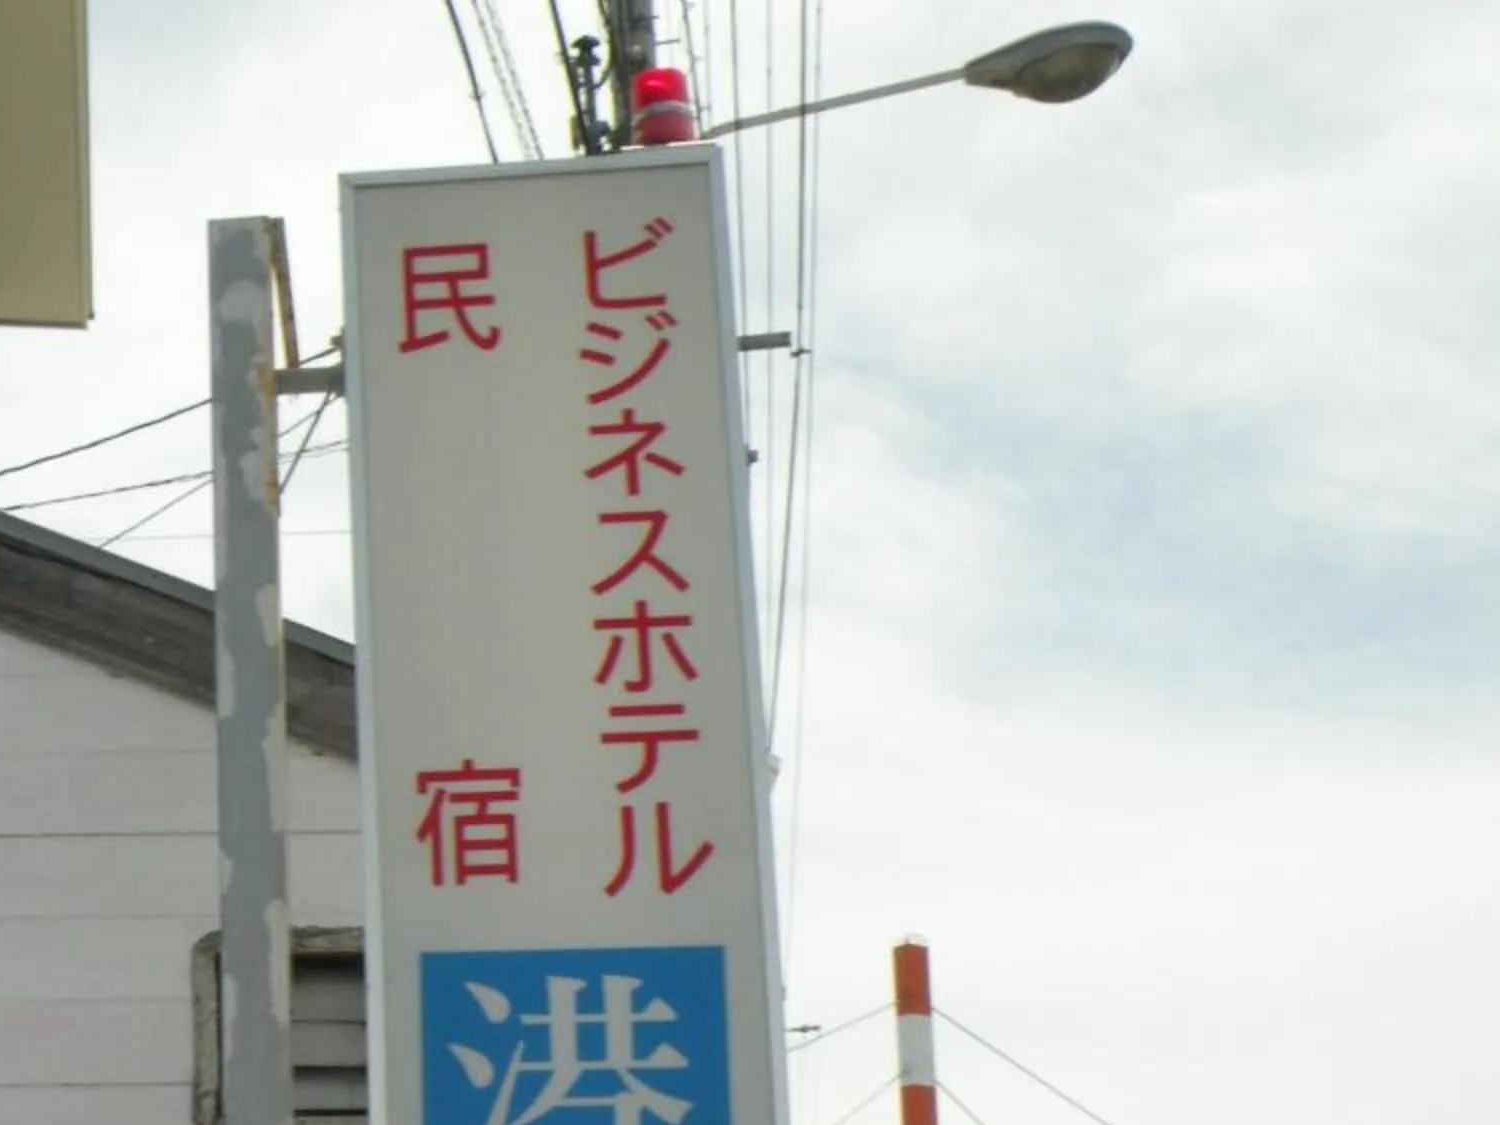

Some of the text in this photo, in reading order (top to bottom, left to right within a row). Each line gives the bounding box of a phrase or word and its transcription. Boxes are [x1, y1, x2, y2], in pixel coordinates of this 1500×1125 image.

[579, 217, 714, 898] ビジネスホテル
